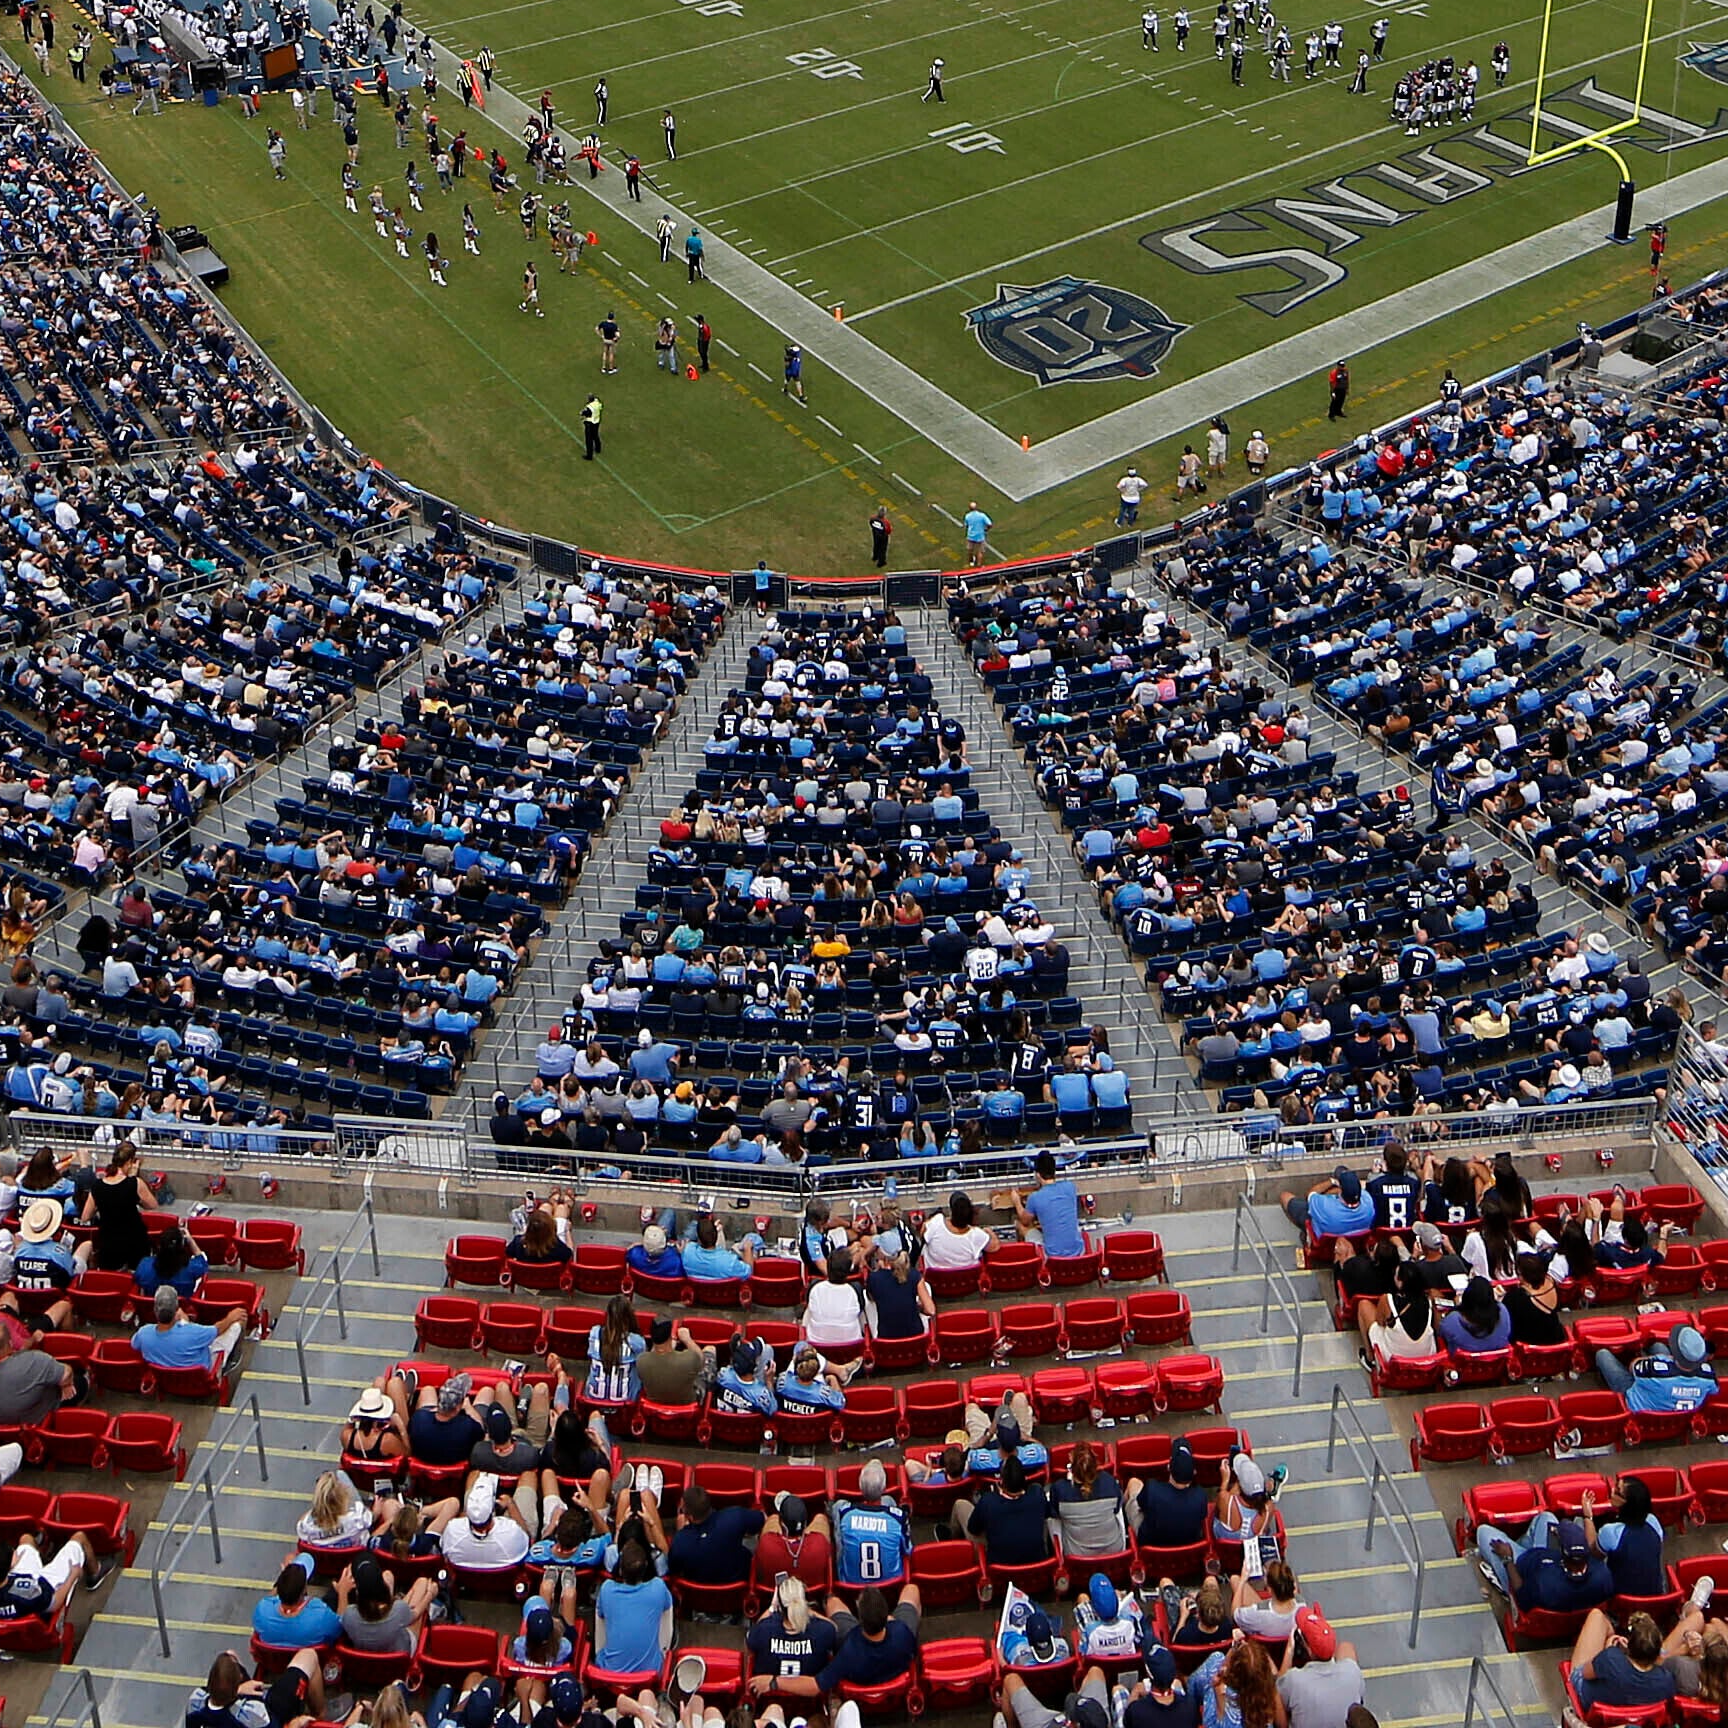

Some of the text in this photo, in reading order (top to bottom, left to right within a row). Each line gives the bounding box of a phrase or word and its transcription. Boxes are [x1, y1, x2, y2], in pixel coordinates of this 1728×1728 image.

[785, 47, 864, 80] 20
[928, 121, 1003, 154] 10
[1444, 382, 1459, 396] 77
[1382, 1184, 1411, 1196] MARIOTA
[1389, 1198, 1408, 1228] 8
[19, 1260, 49, 1272] KEARSE
[1672, 1386, 1701, 1398] MARIOTA
[783, 1399, 816, 1415] WYCHECK
[851, 1515, 887, 1533] MARIOTA
[860, 1541, 882, 1579] 8
[770, 1637, 813, 1656] MARIOTA
[1098, 1635, 1127, 1647] MARIOTA
